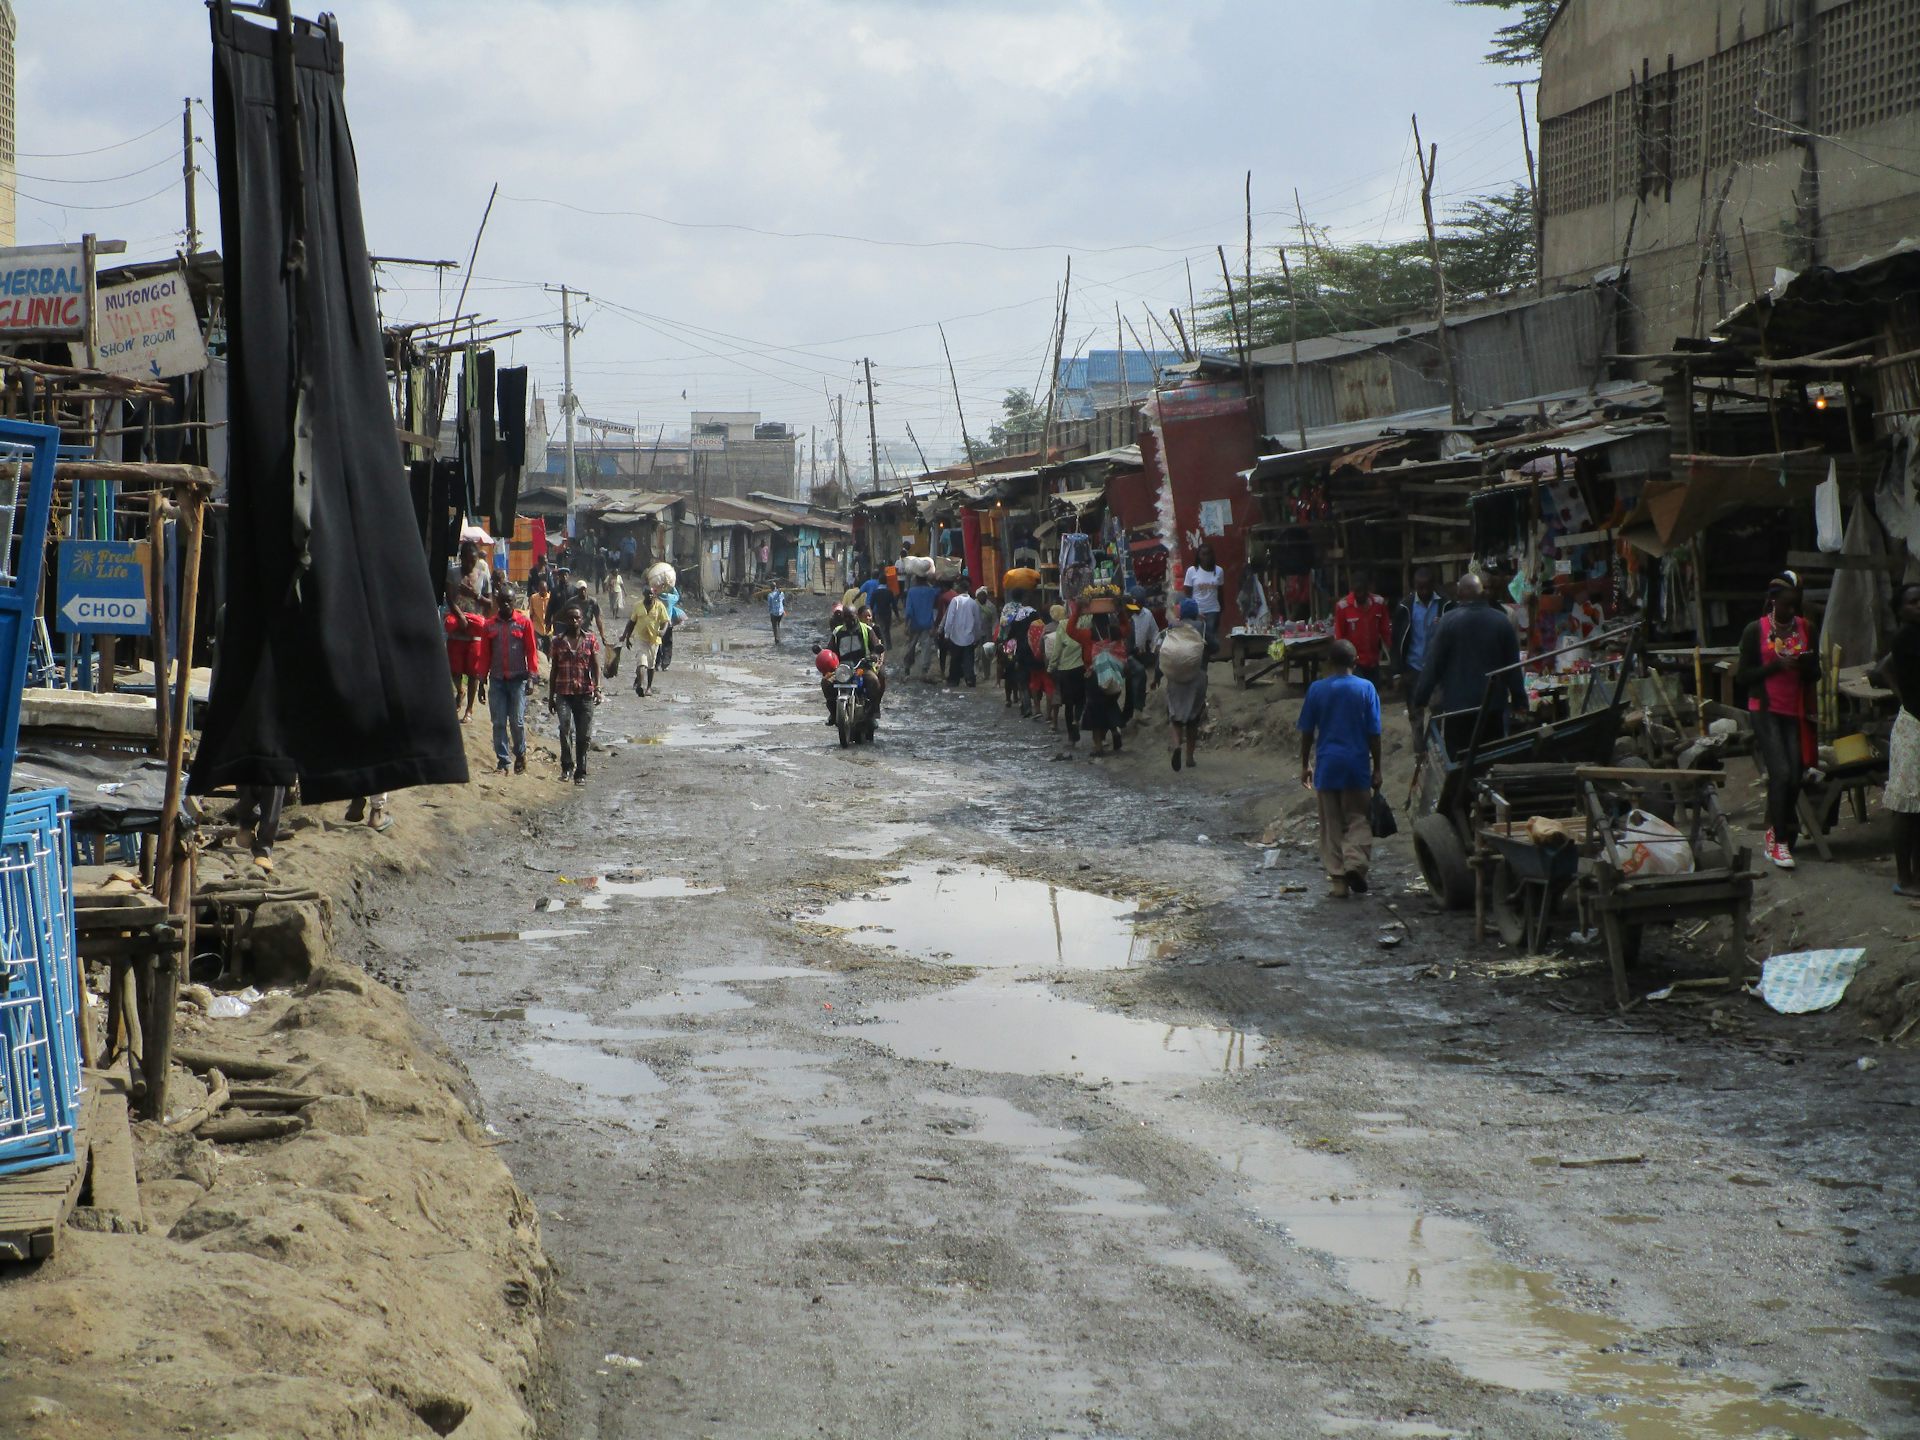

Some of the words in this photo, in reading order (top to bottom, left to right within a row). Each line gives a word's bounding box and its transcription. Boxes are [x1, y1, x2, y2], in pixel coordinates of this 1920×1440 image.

[0, 266, 82, 295] HERBAL
[106, 280, 176, 311] MUTONGOI
[0, 297, 80, 327] CLINIC
[100, 338, 135, 358] SHOW
[142, 329, 176, 347] ROOM
[96, 564, 128, 578] Life
[78, 602, 136, 618] CHOO
